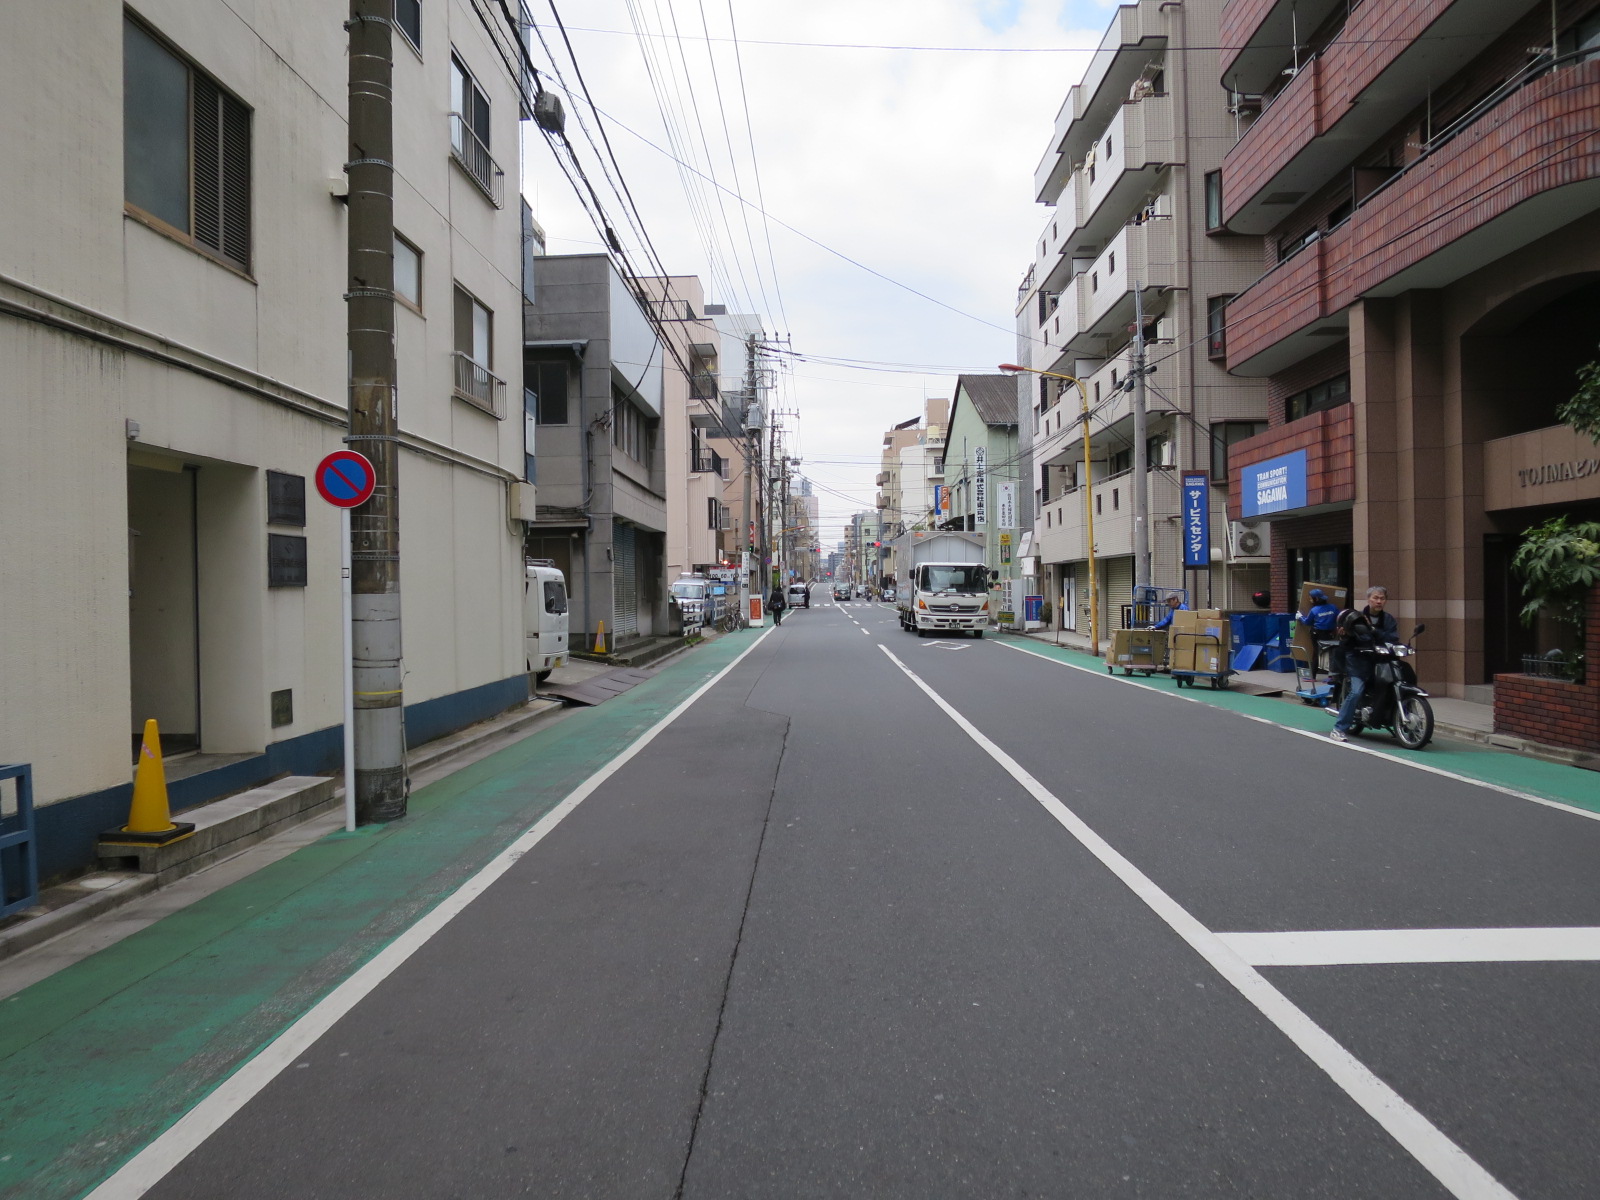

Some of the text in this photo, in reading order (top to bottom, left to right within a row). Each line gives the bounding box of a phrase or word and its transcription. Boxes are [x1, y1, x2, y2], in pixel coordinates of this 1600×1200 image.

[1257, 471, 1269, 482] TRAN
[1257, 485, 1287, 505] SAGAWA
[1189, 490, 1202, 561] サービスセンター
